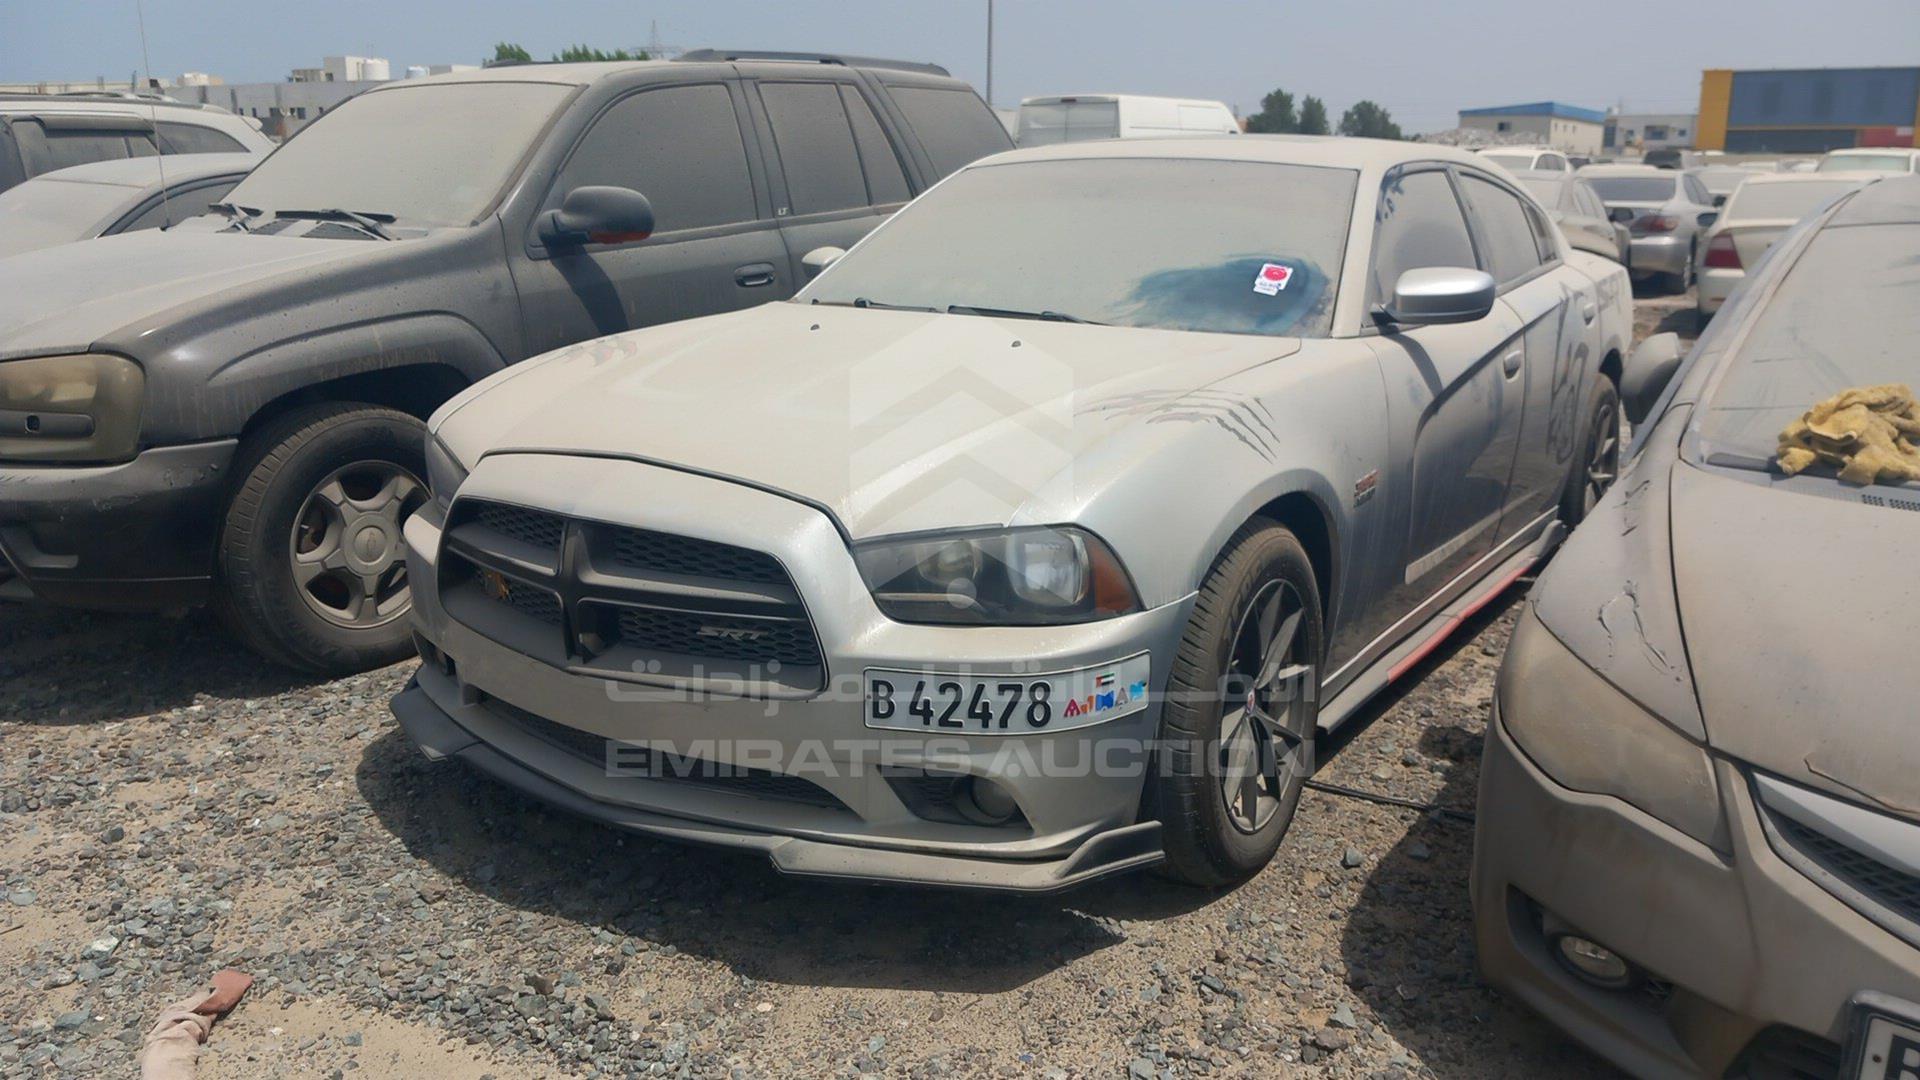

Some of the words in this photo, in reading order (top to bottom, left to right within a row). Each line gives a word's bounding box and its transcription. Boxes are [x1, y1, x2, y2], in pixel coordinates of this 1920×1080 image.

[696, 626, 769, 641] SRT
[871, 679, 896, 719] B
[908, 680, 1052, 729] 42478
